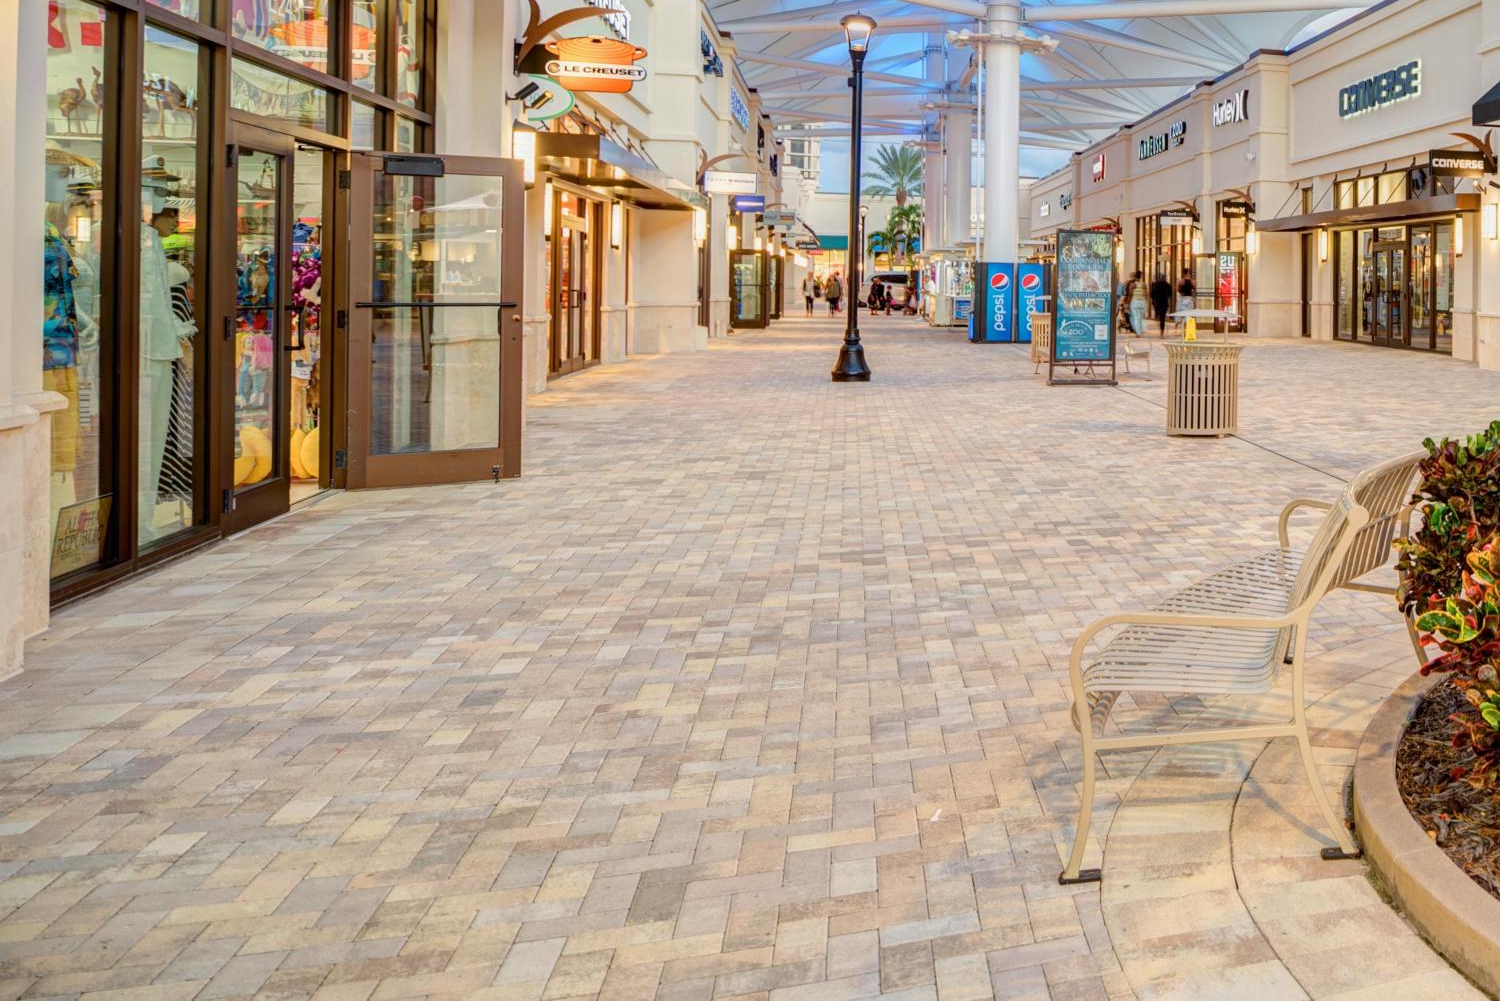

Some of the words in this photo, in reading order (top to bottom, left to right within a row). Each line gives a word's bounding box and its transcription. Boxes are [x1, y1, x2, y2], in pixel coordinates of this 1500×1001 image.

[582, 67, 644, 77] CREUSET
[1339, 59, 1420, 118] CONVERSE
[1213, 98, 1235, 127] Hurley
[1432, 158, 1484, 169] CONVERSE
[992, 293, 1007, 331] pepsi
